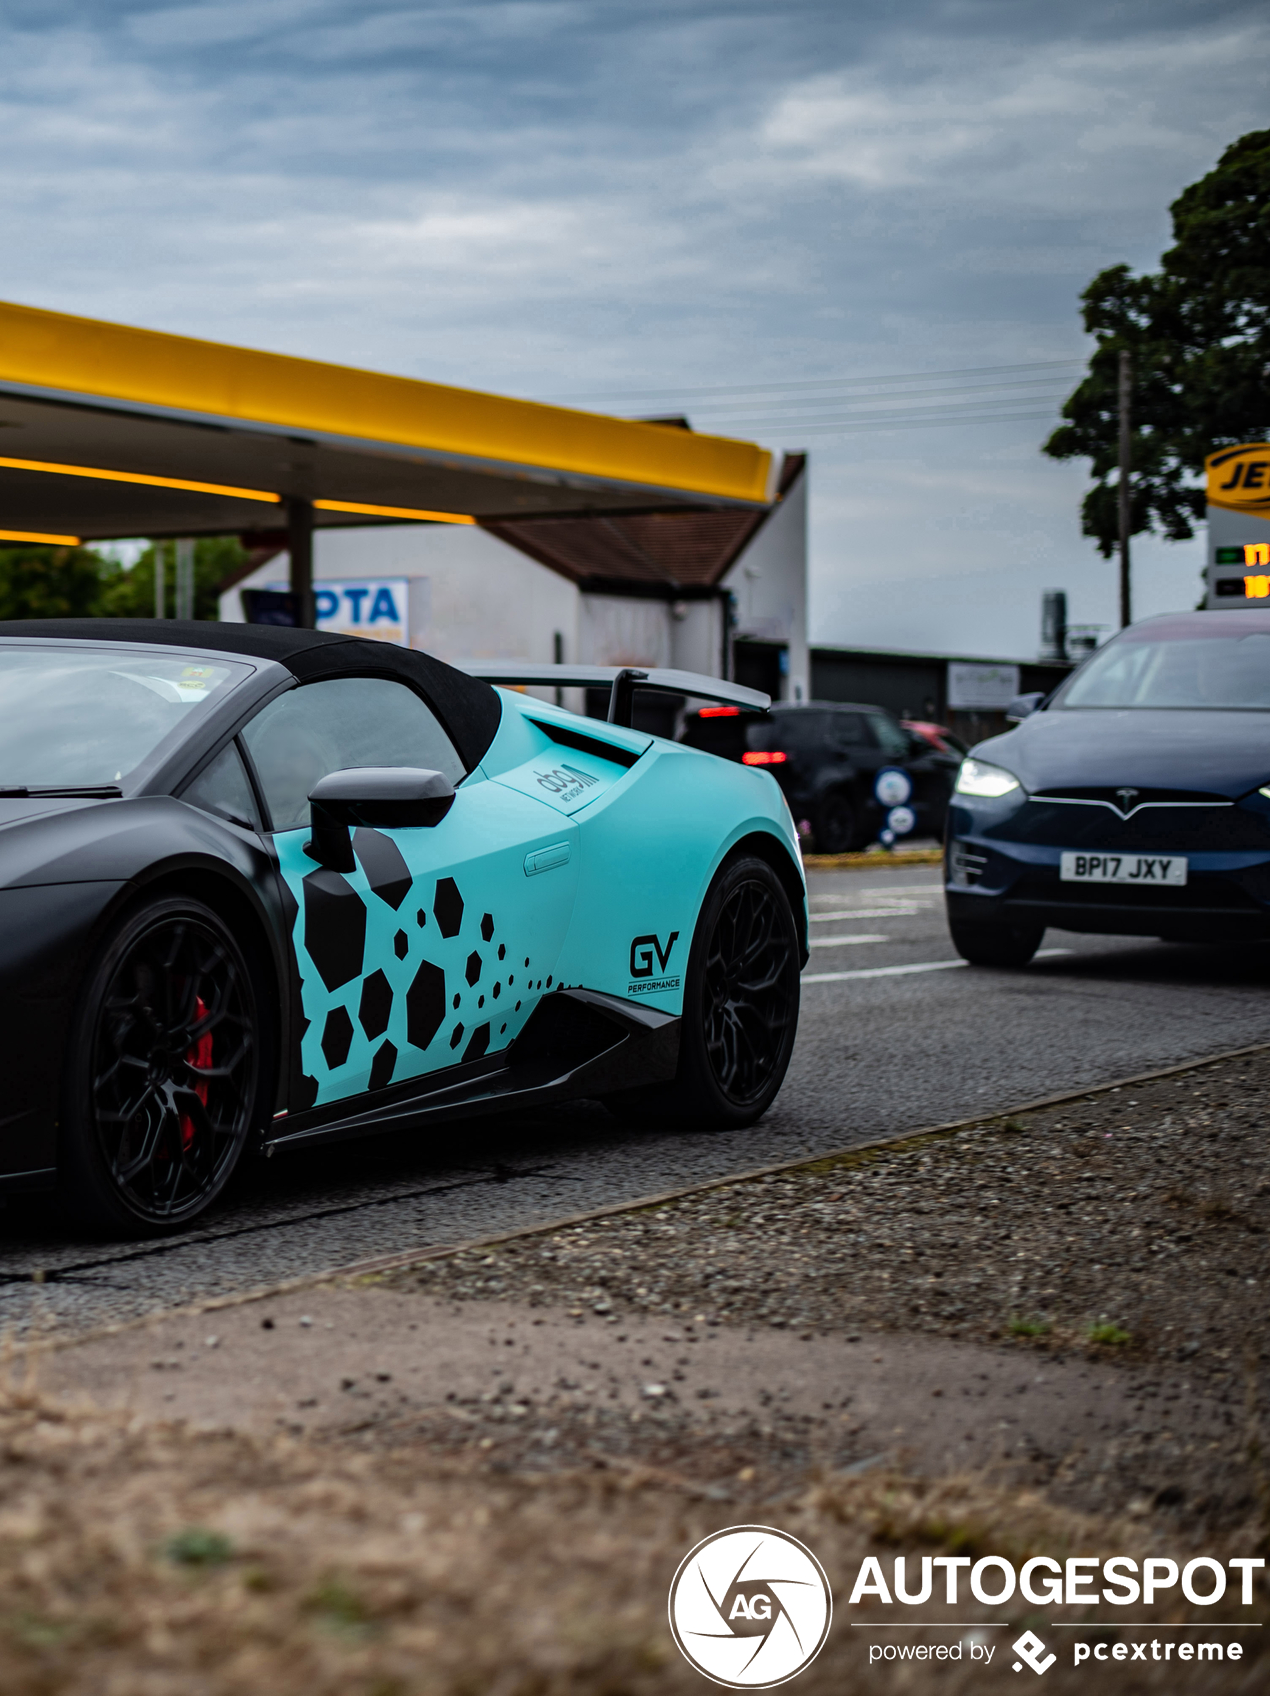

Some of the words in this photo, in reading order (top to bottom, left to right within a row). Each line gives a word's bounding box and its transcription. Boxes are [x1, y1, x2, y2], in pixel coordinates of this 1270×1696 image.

[1220, 461, 1270, 489] JE
[1074, 856, 1122, 877] BP17
[1128, 858, 1172, 879] JXY
[630, 931, 679, 978] GV
[628, 979, 680, 993] PERFORMANCE
